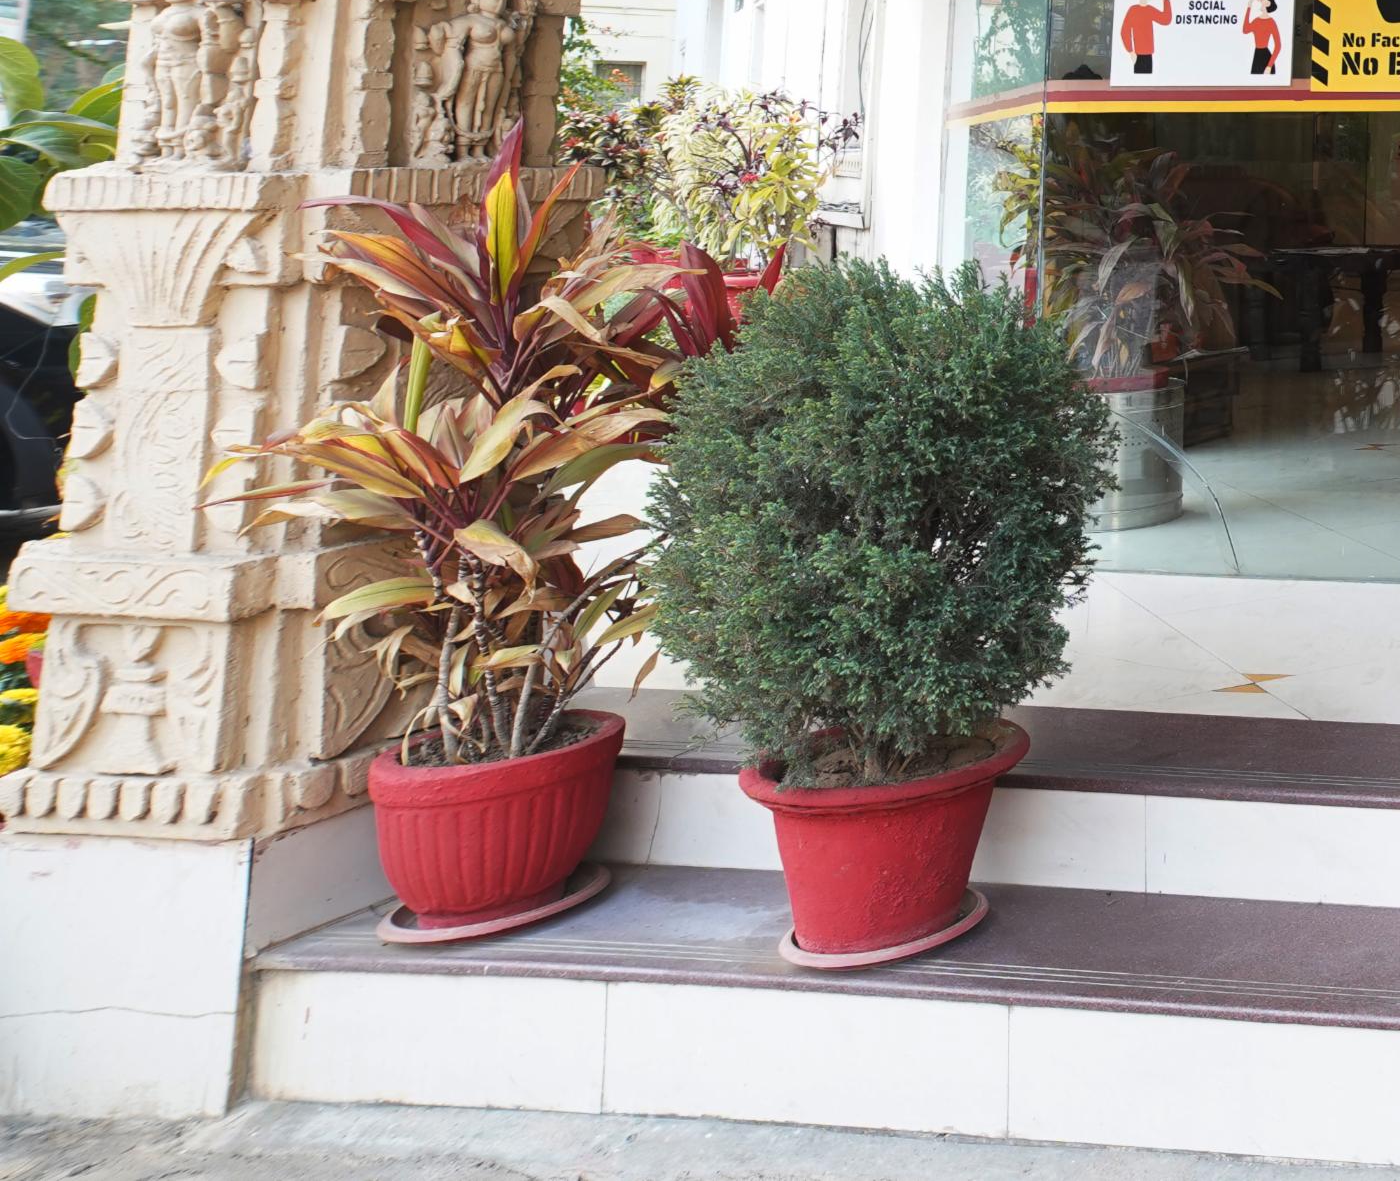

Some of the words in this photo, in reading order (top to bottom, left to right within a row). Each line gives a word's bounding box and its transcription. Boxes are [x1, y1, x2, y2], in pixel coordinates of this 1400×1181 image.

[1188, 0, 1226, 10] SOCIAL
[1175, 14, 1238, 25] DISTANCING
[1342, 32, 1366, 47] No
[1341, 52, 1379, 75] No
